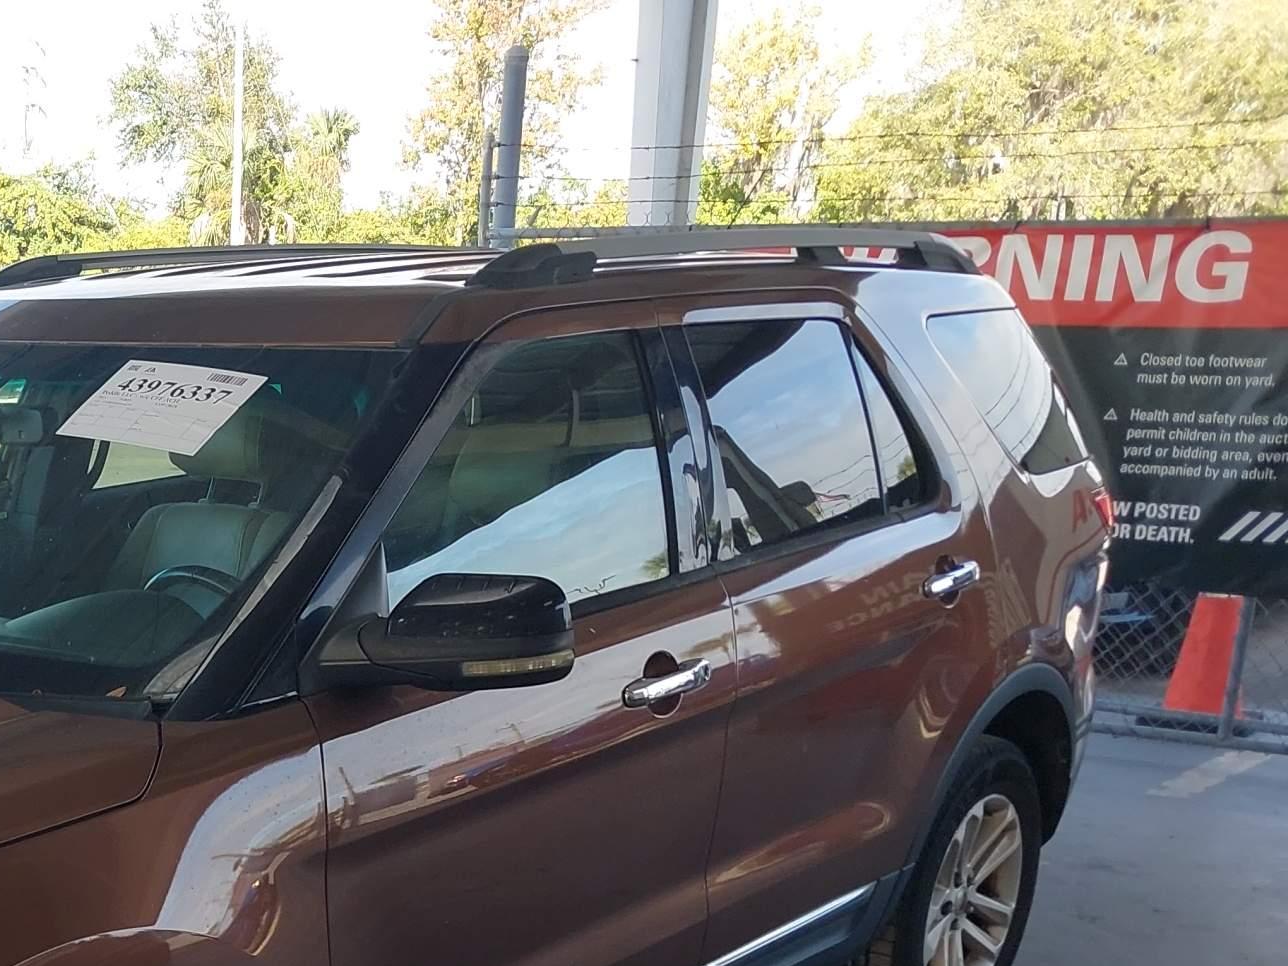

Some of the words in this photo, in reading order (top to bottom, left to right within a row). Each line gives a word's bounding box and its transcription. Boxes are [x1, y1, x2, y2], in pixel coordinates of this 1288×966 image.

[1140, 352, 1182, 367] Closed
[1185, 355, 1205, 368] toe
[1209, 354, 1268, 368] footwear
[1137, 373, 1168, 385] must
[1170, 372, 1186, 385] be
[1190, 375, 1222, 386] worn
[1225, 376, 1241, 387] on
[1245, 374, 1276, 389] yard.
[118, 377, 234, 405] 43976337
[1130, 408, 1169, 422] Health
[1172, 410, 1195, 423] and
[1198, 411, 1236, 427] safety
[1239, 412, 1269, 426] rules
[1272, 413, 1288, 427] do
[1126, 426, 1166, 441] permit
[1168, 428, 1216, 442] children
[1219, 430, 1231, 443] in
[1235, 431, 1255, 444] the
[1123, 445, 1152, 458] yard
[1155, 447, 1169, 458] or
[1172, 446, 1217, 462] bidding
[1221, 450, 1253, 463] area,
[1257, 451, 1288, 463] even
[1119, 463, 1202, 478] accompanied
[1204, 466, 1219, 480] by
[1222, 468, 1238, 479] an
[1241, 467, 1278, 480] adult.
[1133, 501, 1201, 521] POSTED
[1134, 524, 1195, 544] DEATH.
